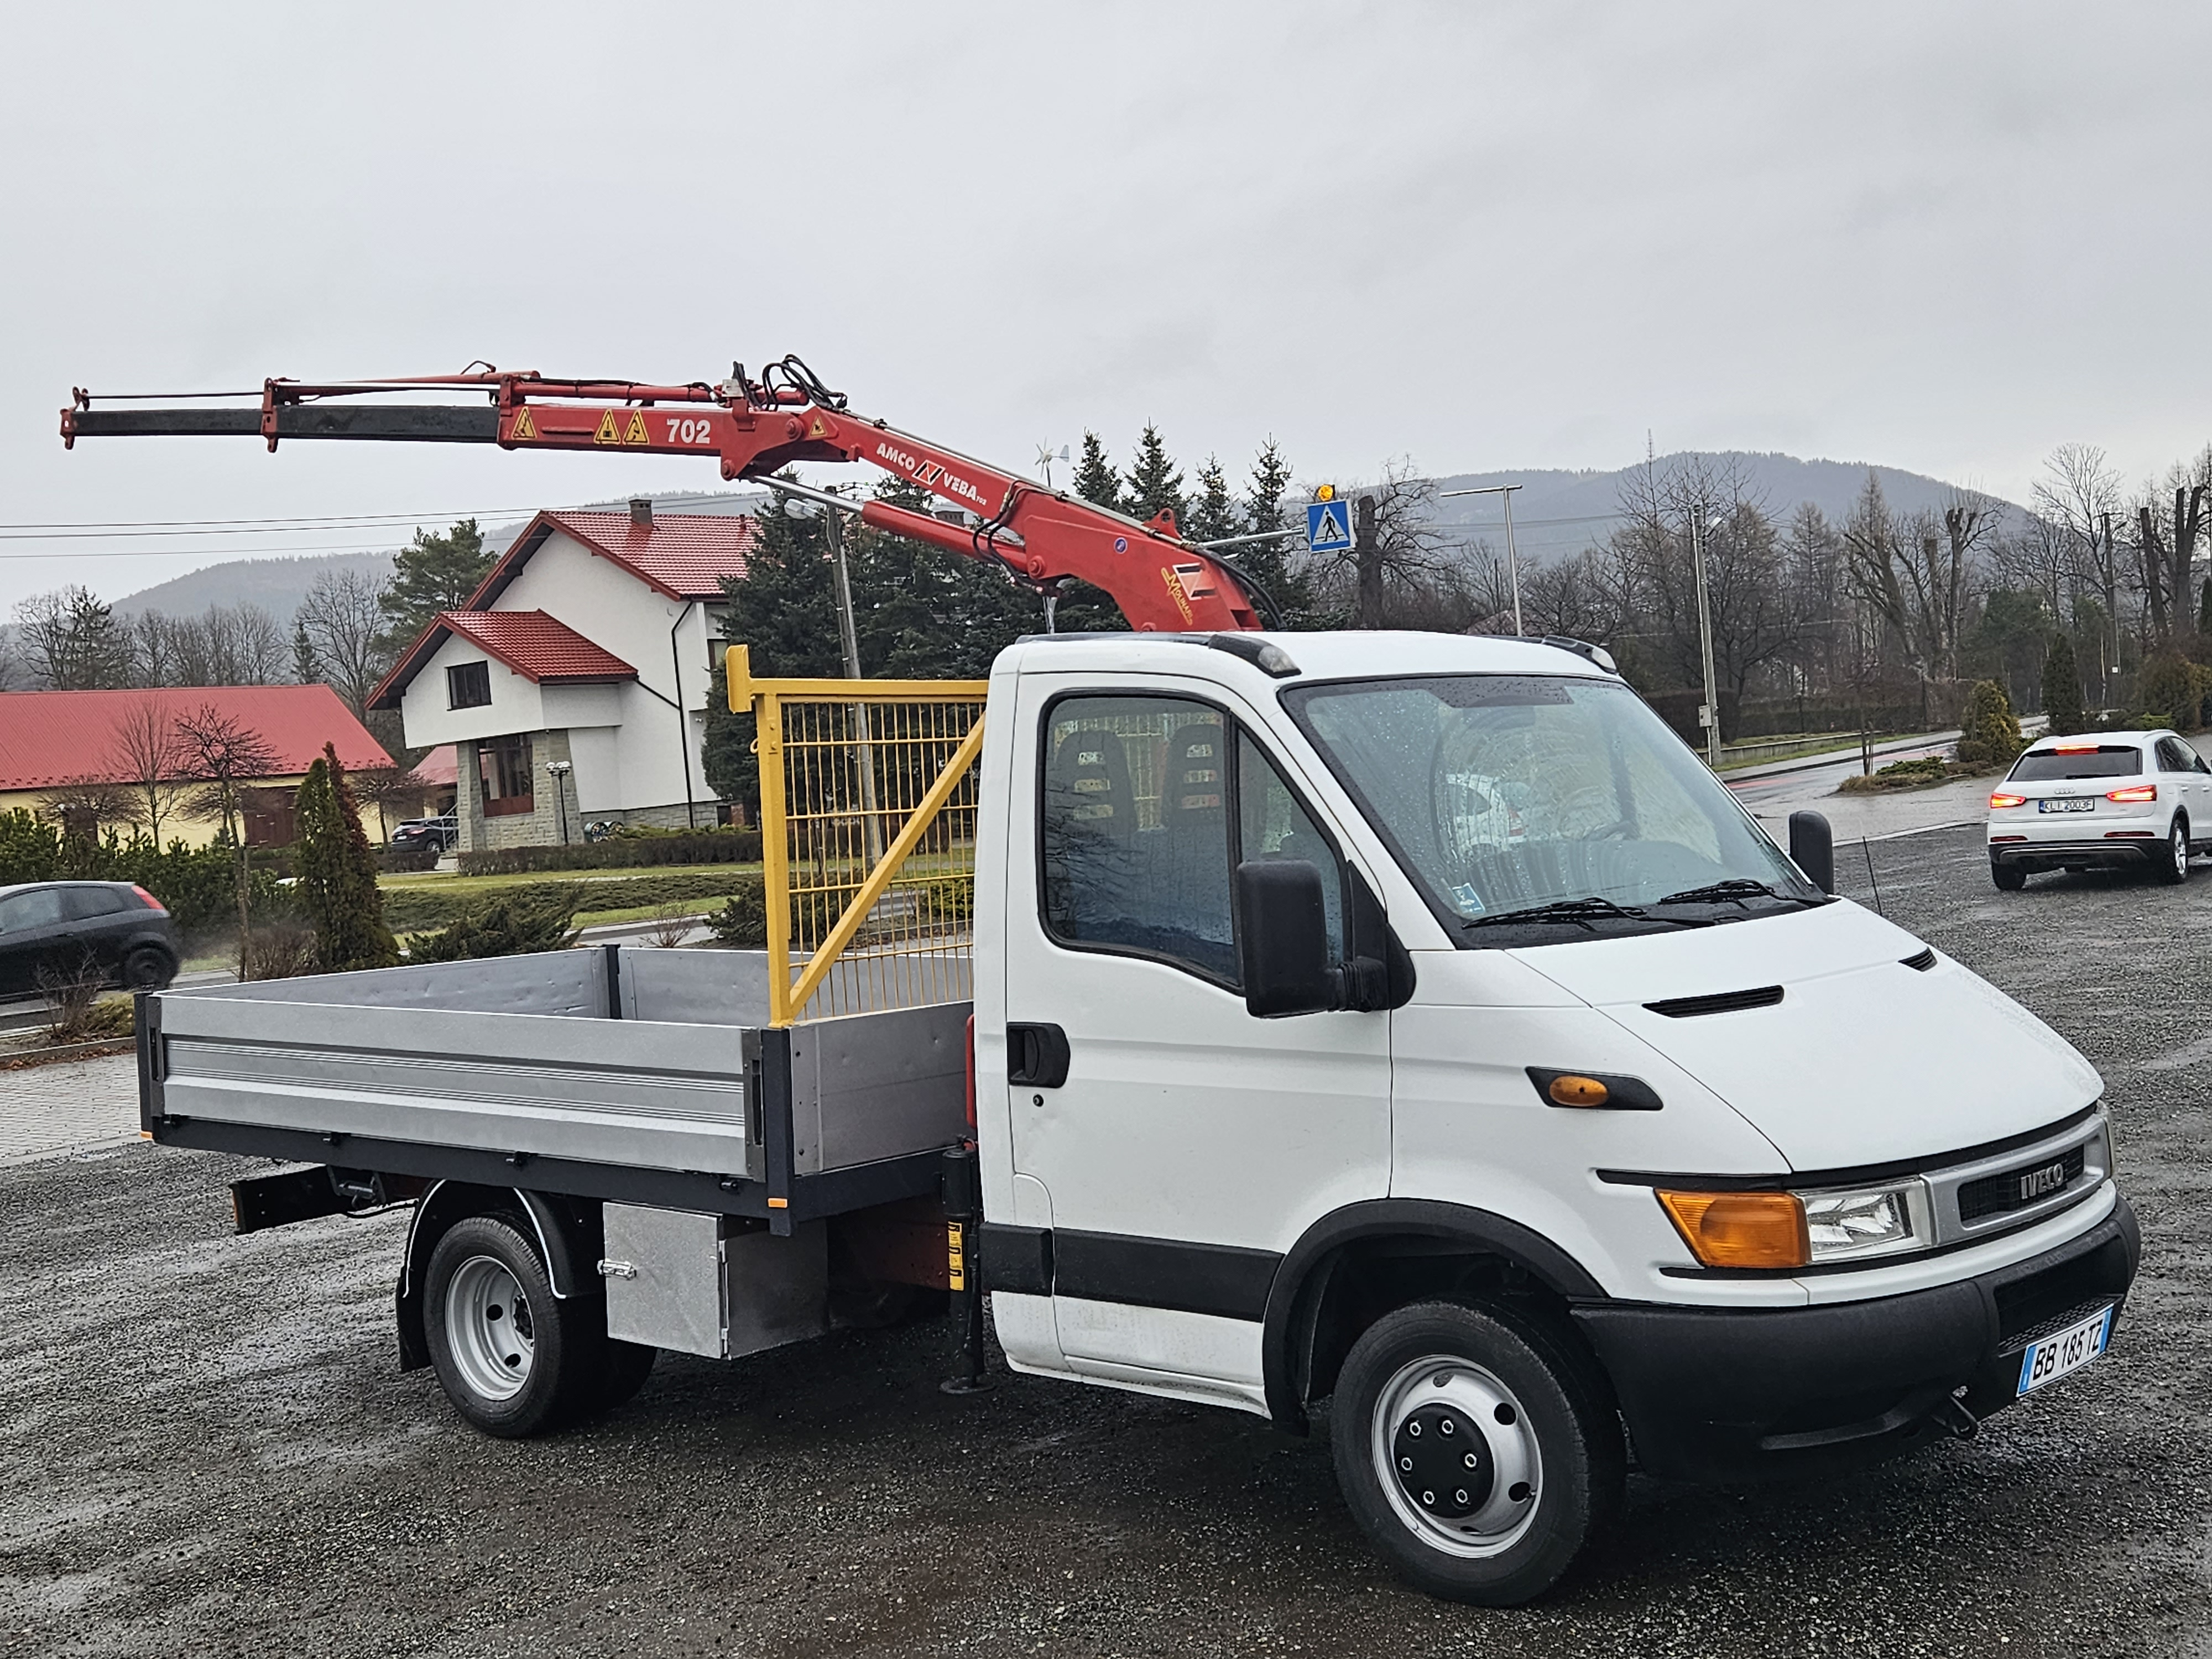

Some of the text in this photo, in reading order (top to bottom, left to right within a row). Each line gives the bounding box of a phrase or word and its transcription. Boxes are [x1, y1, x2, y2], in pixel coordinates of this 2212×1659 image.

[666, 419, 711, 444] 702
[876, 442, 915, 471] AMCO
[943, 472, 977, 500] VEBA
[2021, 1164, 2064, 1199] IVECO
[2032, 1318, 2104, 1381] BB 185 TZ
